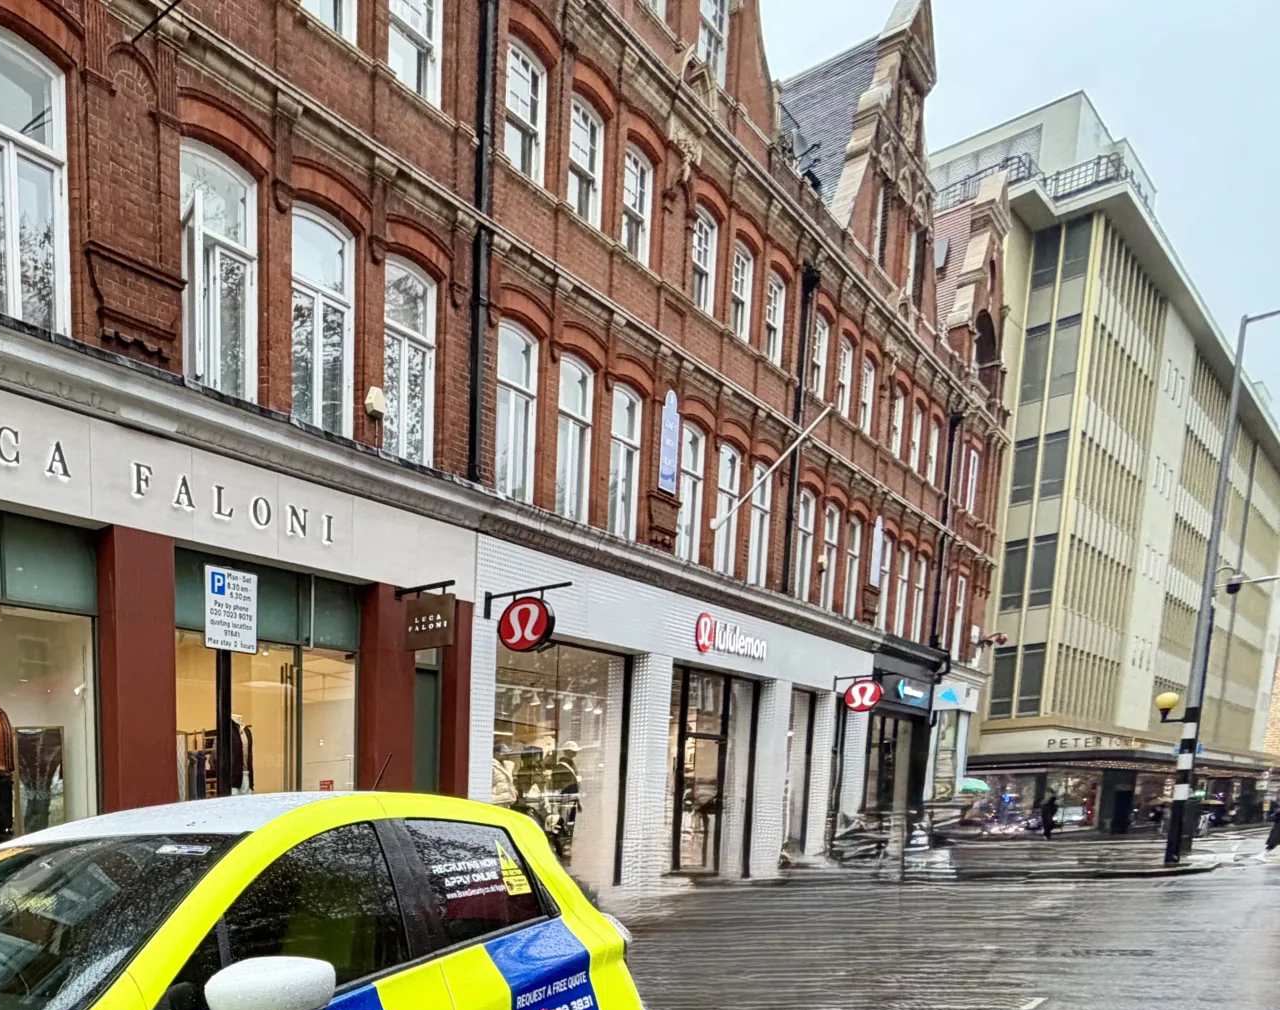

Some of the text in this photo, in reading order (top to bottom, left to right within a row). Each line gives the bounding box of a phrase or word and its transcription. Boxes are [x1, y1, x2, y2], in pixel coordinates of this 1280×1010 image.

[134, 462, 333, 543] FALONI
[214, 574, 223, 592] P
[242, 575, 252, 584] Sat
[214, 600, 249, 613] Pay by phone
[210, 619, 253, 630] quoting location
[414, 613, 442, 623] LUCA
[408, 620, 447, 632] FALONI
[208, 636, 219, 645] Max
[220, 638, 232, 648] stay
[715, 620, 767, 660] lululemon
[1047, 736, 1101, 749] PETER
[431, 857, 498, 875] RECRUITING NOW
[444, 874, 470, 887] APPLY
[471, 871, 499, 883] ONLINE
[516, 971, 587, 1009] REQUEST A FREE QUOTE
